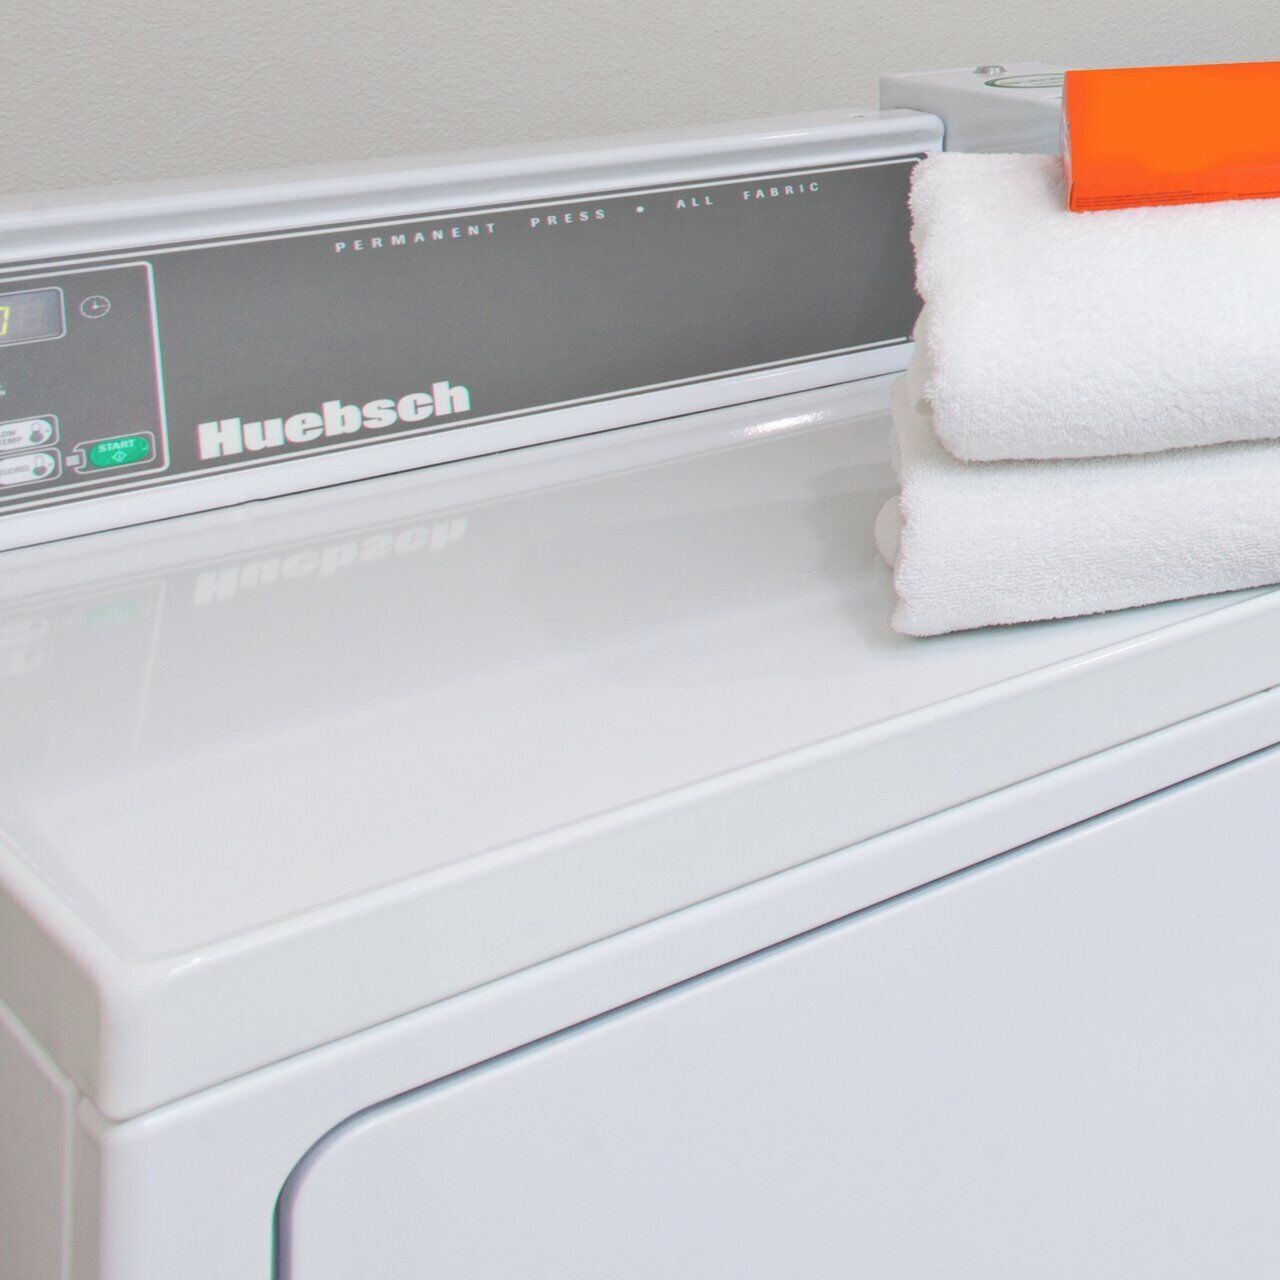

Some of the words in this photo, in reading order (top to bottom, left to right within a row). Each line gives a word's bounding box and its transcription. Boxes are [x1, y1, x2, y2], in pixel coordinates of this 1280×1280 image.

[335, 221, 496, 253] PERMANENT
[530, 208, 606, 228] PRESS
[676, 194, 715, 209] ALL
[743, 180, 821, 201] FABRIC
[98, 438, 136, 453] START
[197, 380, 471, 461] Huebsch
